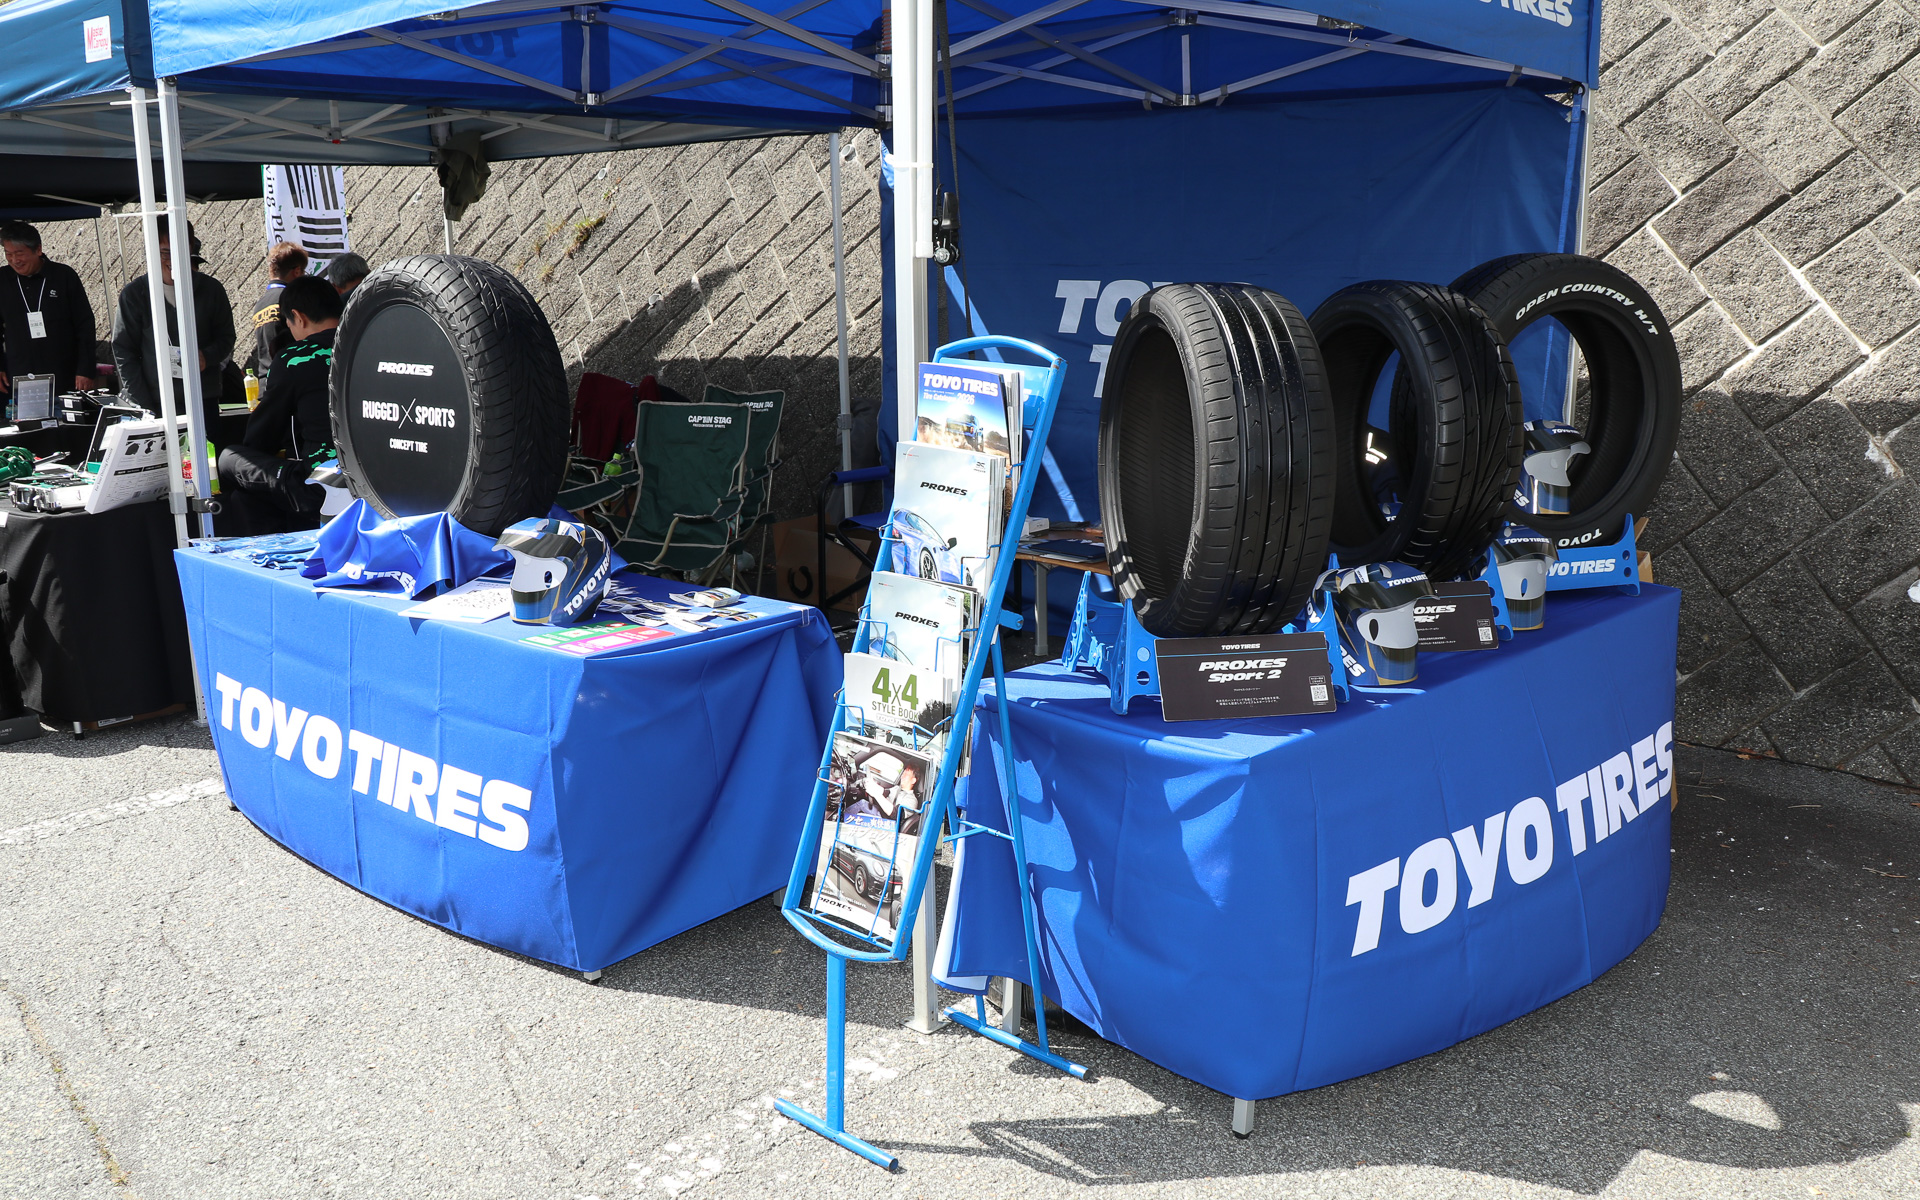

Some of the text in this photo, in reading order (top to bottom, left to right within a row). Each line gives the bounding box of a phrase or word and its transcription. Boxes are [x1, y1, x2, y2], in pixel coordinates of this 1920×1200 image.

[1055, 279, 1174, 337] TO
[1515, 283, 1659, 336] OPEN COUNTRY H/T
[377, 361, 434, 377] PROXES
[923, 373, 999, 397] TOYO TIRES
[362, 399, 400, 422] RUGGED
[415, 405, 456, 428] SPORTS
[713, 416, 732, 424] STAG
[389, 438, 428, 453] CONCEPT TIRE
[920, 481, 968, 496] PROXES
[1504, 537, 1528, 545] TOYO
[1558, 528, 1603, 548] TOYO
[1546, 559, 1616, 577] YO TIRES
[1387, 577, 1412, 587] TOYO
[563, 576, 597, 616] TOYO
[1414, 604, 1457, 614] OXES
[895, 611, 940, 629] PROXES
[1199, 658, 1288, 672] PROXES
[1208, 669, 1283, 684] Sport 2
[872, 701, 919, 723] STYLE BOOK
[216, 671, 533, 852] TOYO TIRES
[1345, 720, 1674, 958] TOYO TIRES
